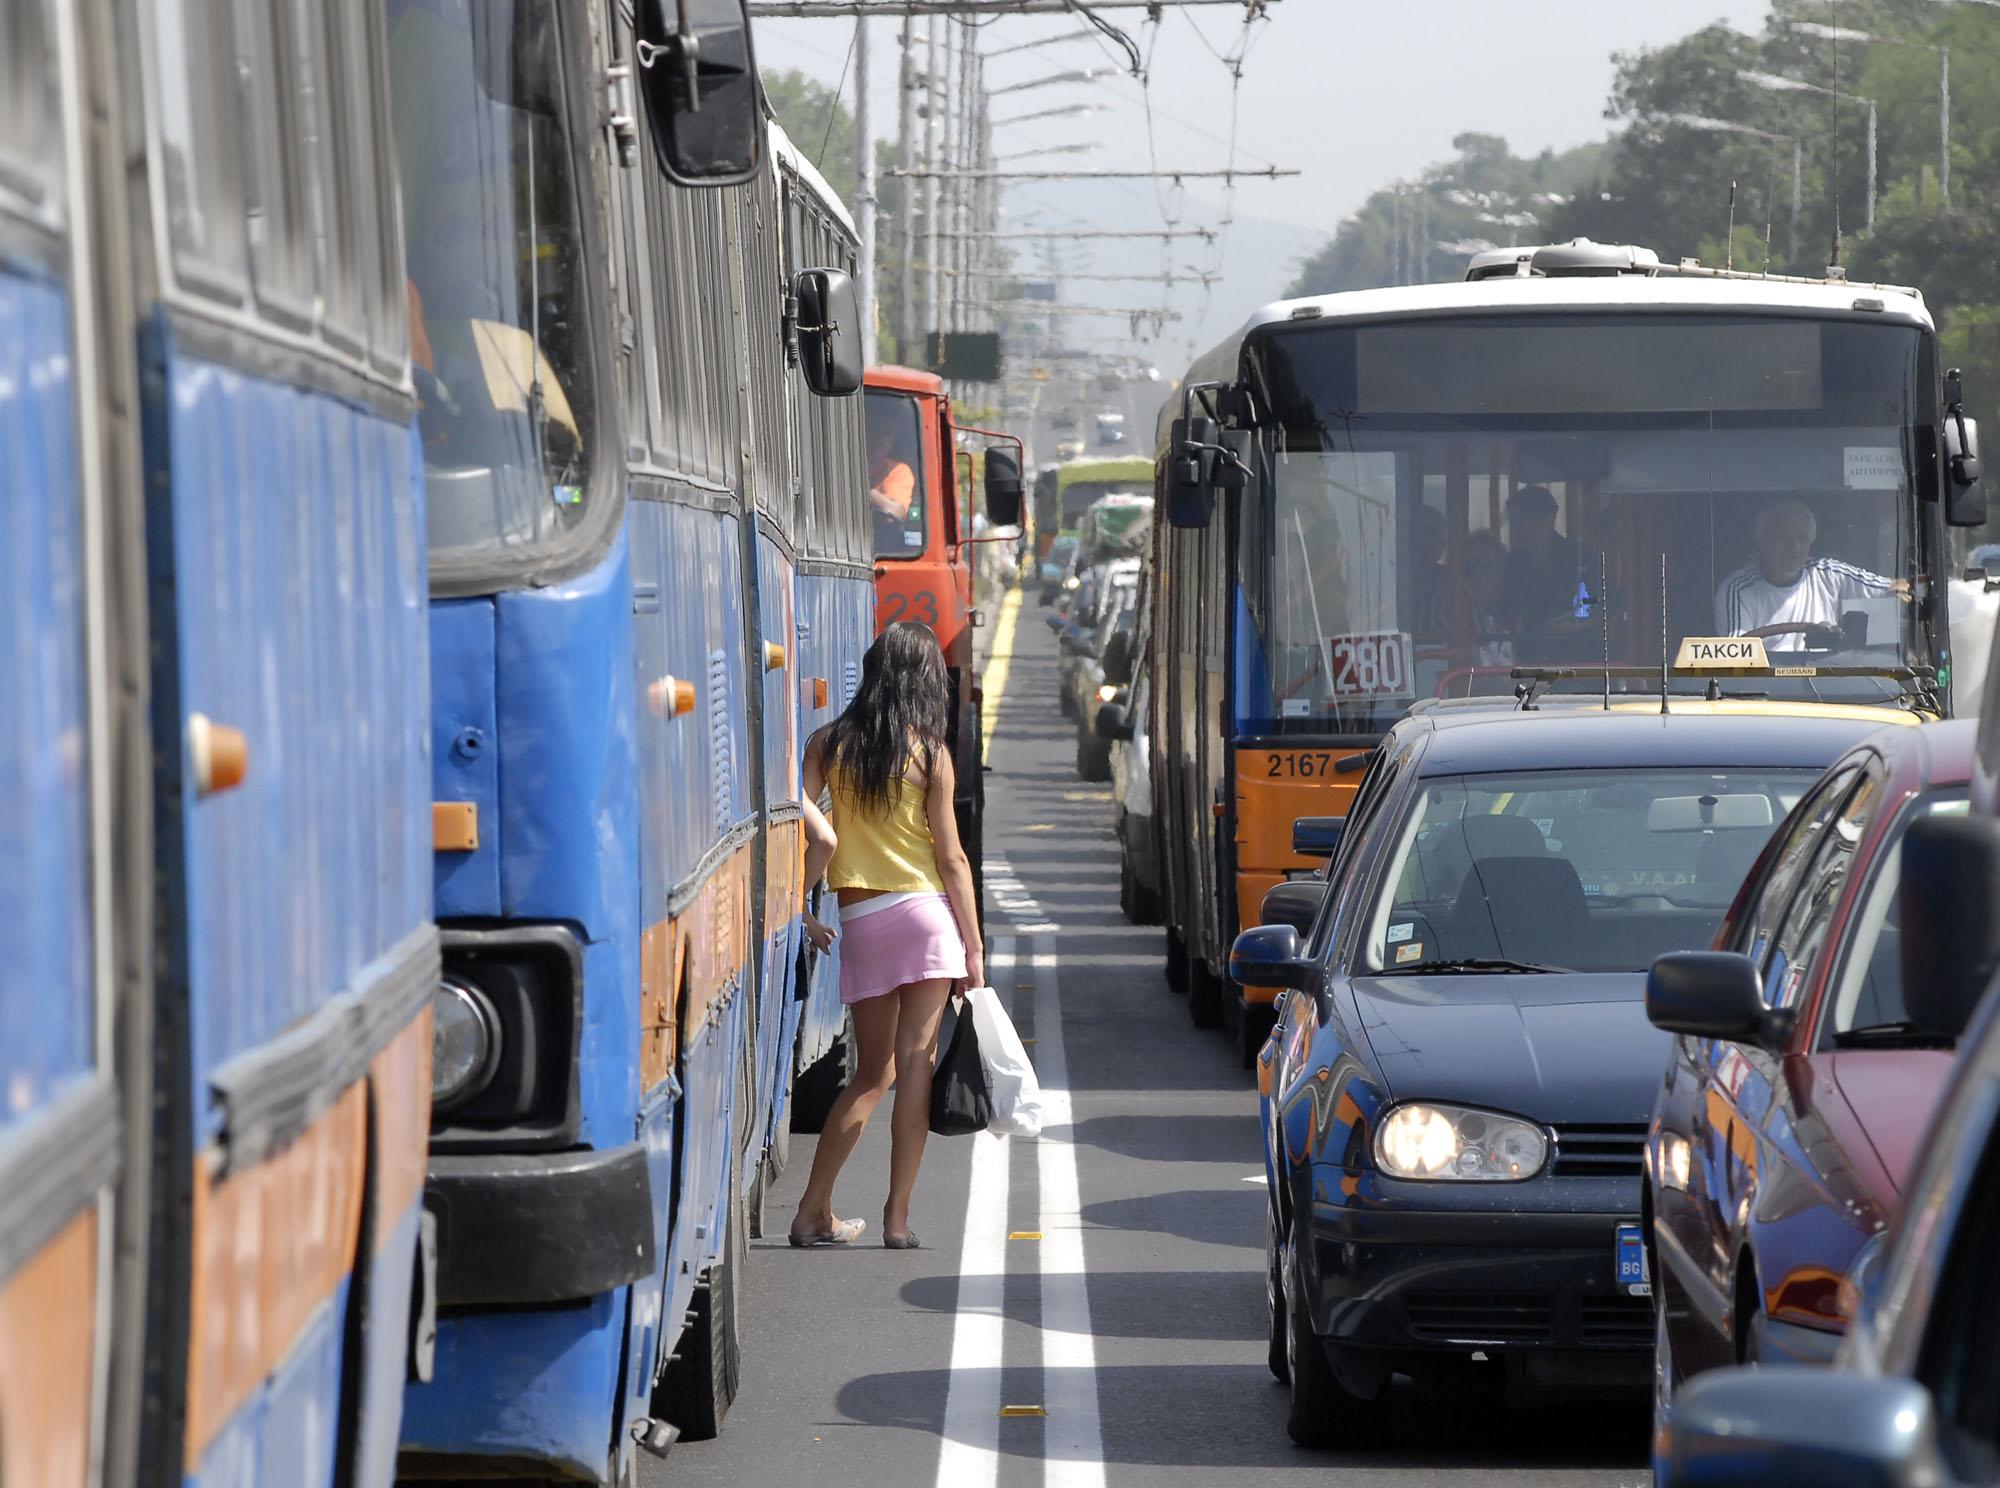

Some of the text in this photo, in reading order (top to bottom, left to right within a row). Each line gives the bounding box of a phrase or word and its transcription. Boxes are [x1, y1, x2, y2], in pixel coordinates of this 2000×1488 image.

[885, 590, 938, 626] 23
[1691, 643, 1753, 659] ТАКСИ
[1334, 638, 1401, 692] 280
[1267, 753, 1331, 777] 2167
[1622, 1262, 1641, 1275] BG
